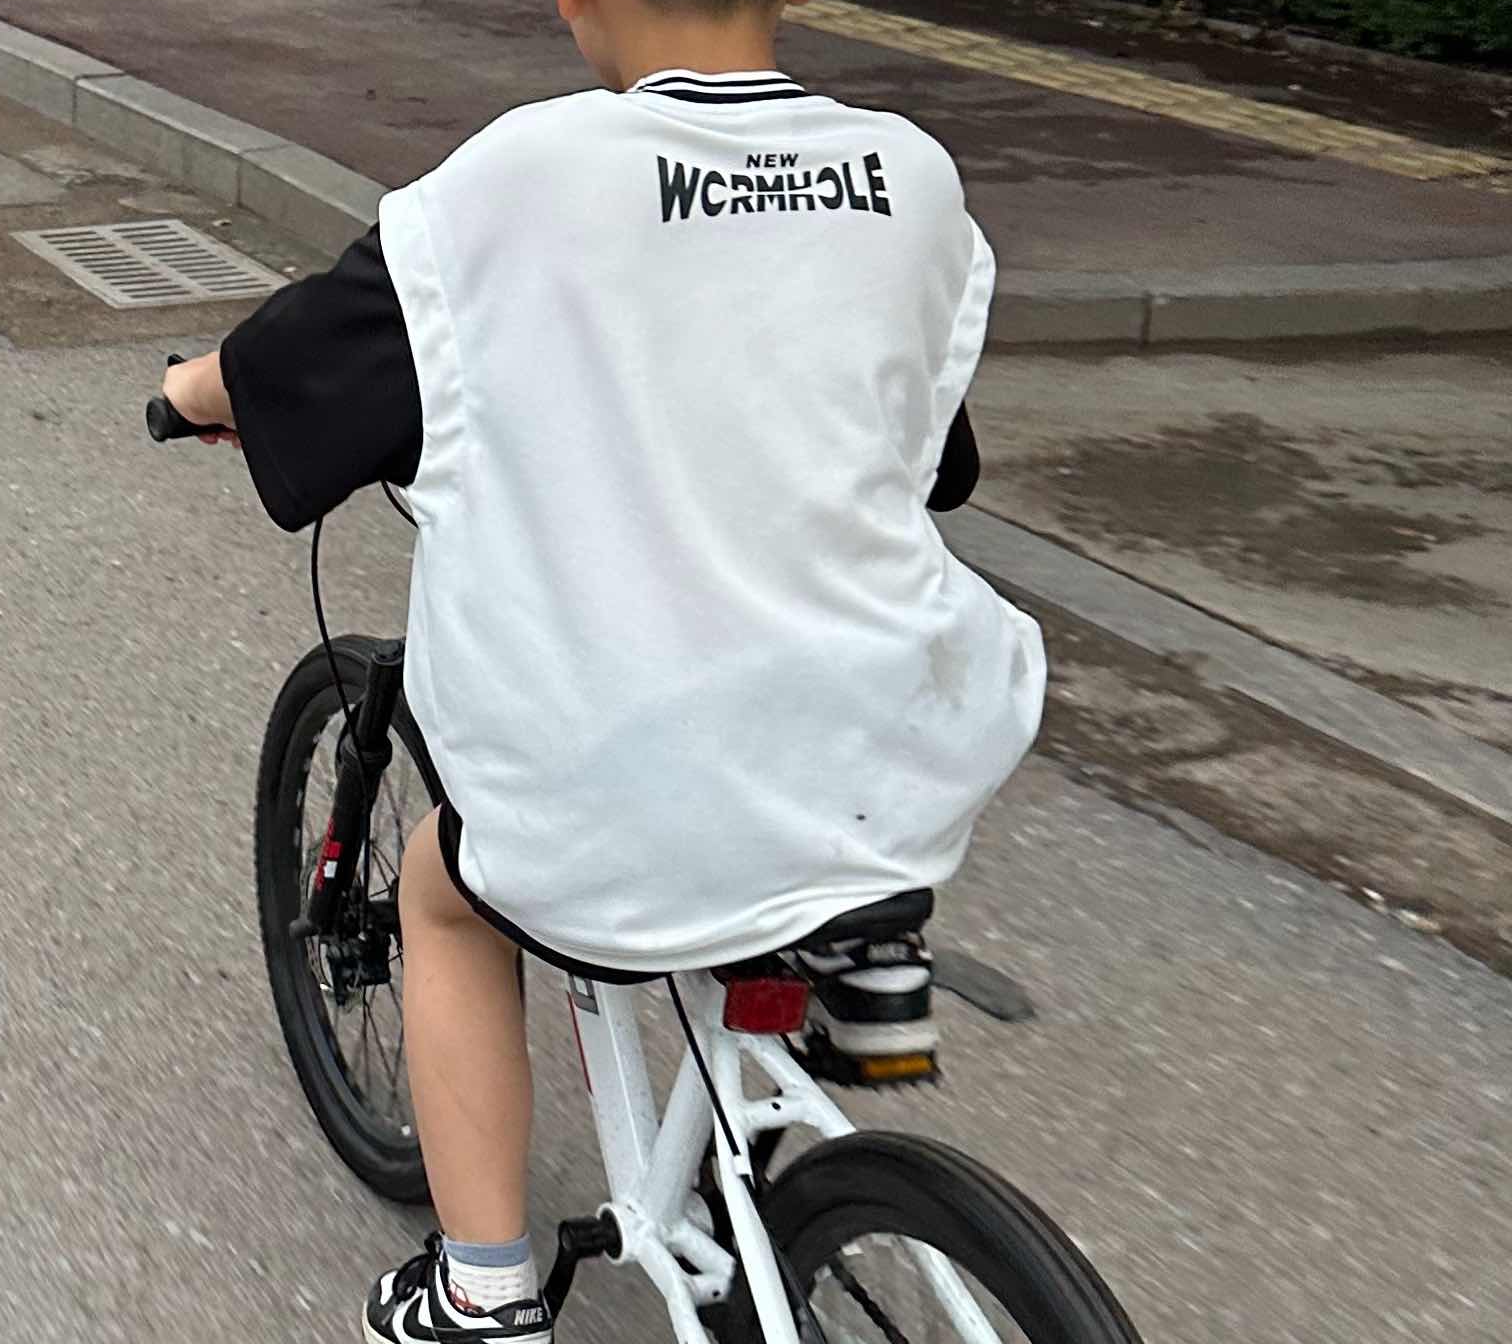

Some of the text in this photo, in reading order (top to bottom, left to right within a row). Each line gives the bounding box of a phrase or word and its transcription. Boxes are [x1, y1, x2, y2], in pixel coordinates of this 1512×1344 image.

[746, 153, 799, 168] NEW
[656, 152, 892, 223] WORMHOLE
[514, 1307, 543, 1326] NIKE
